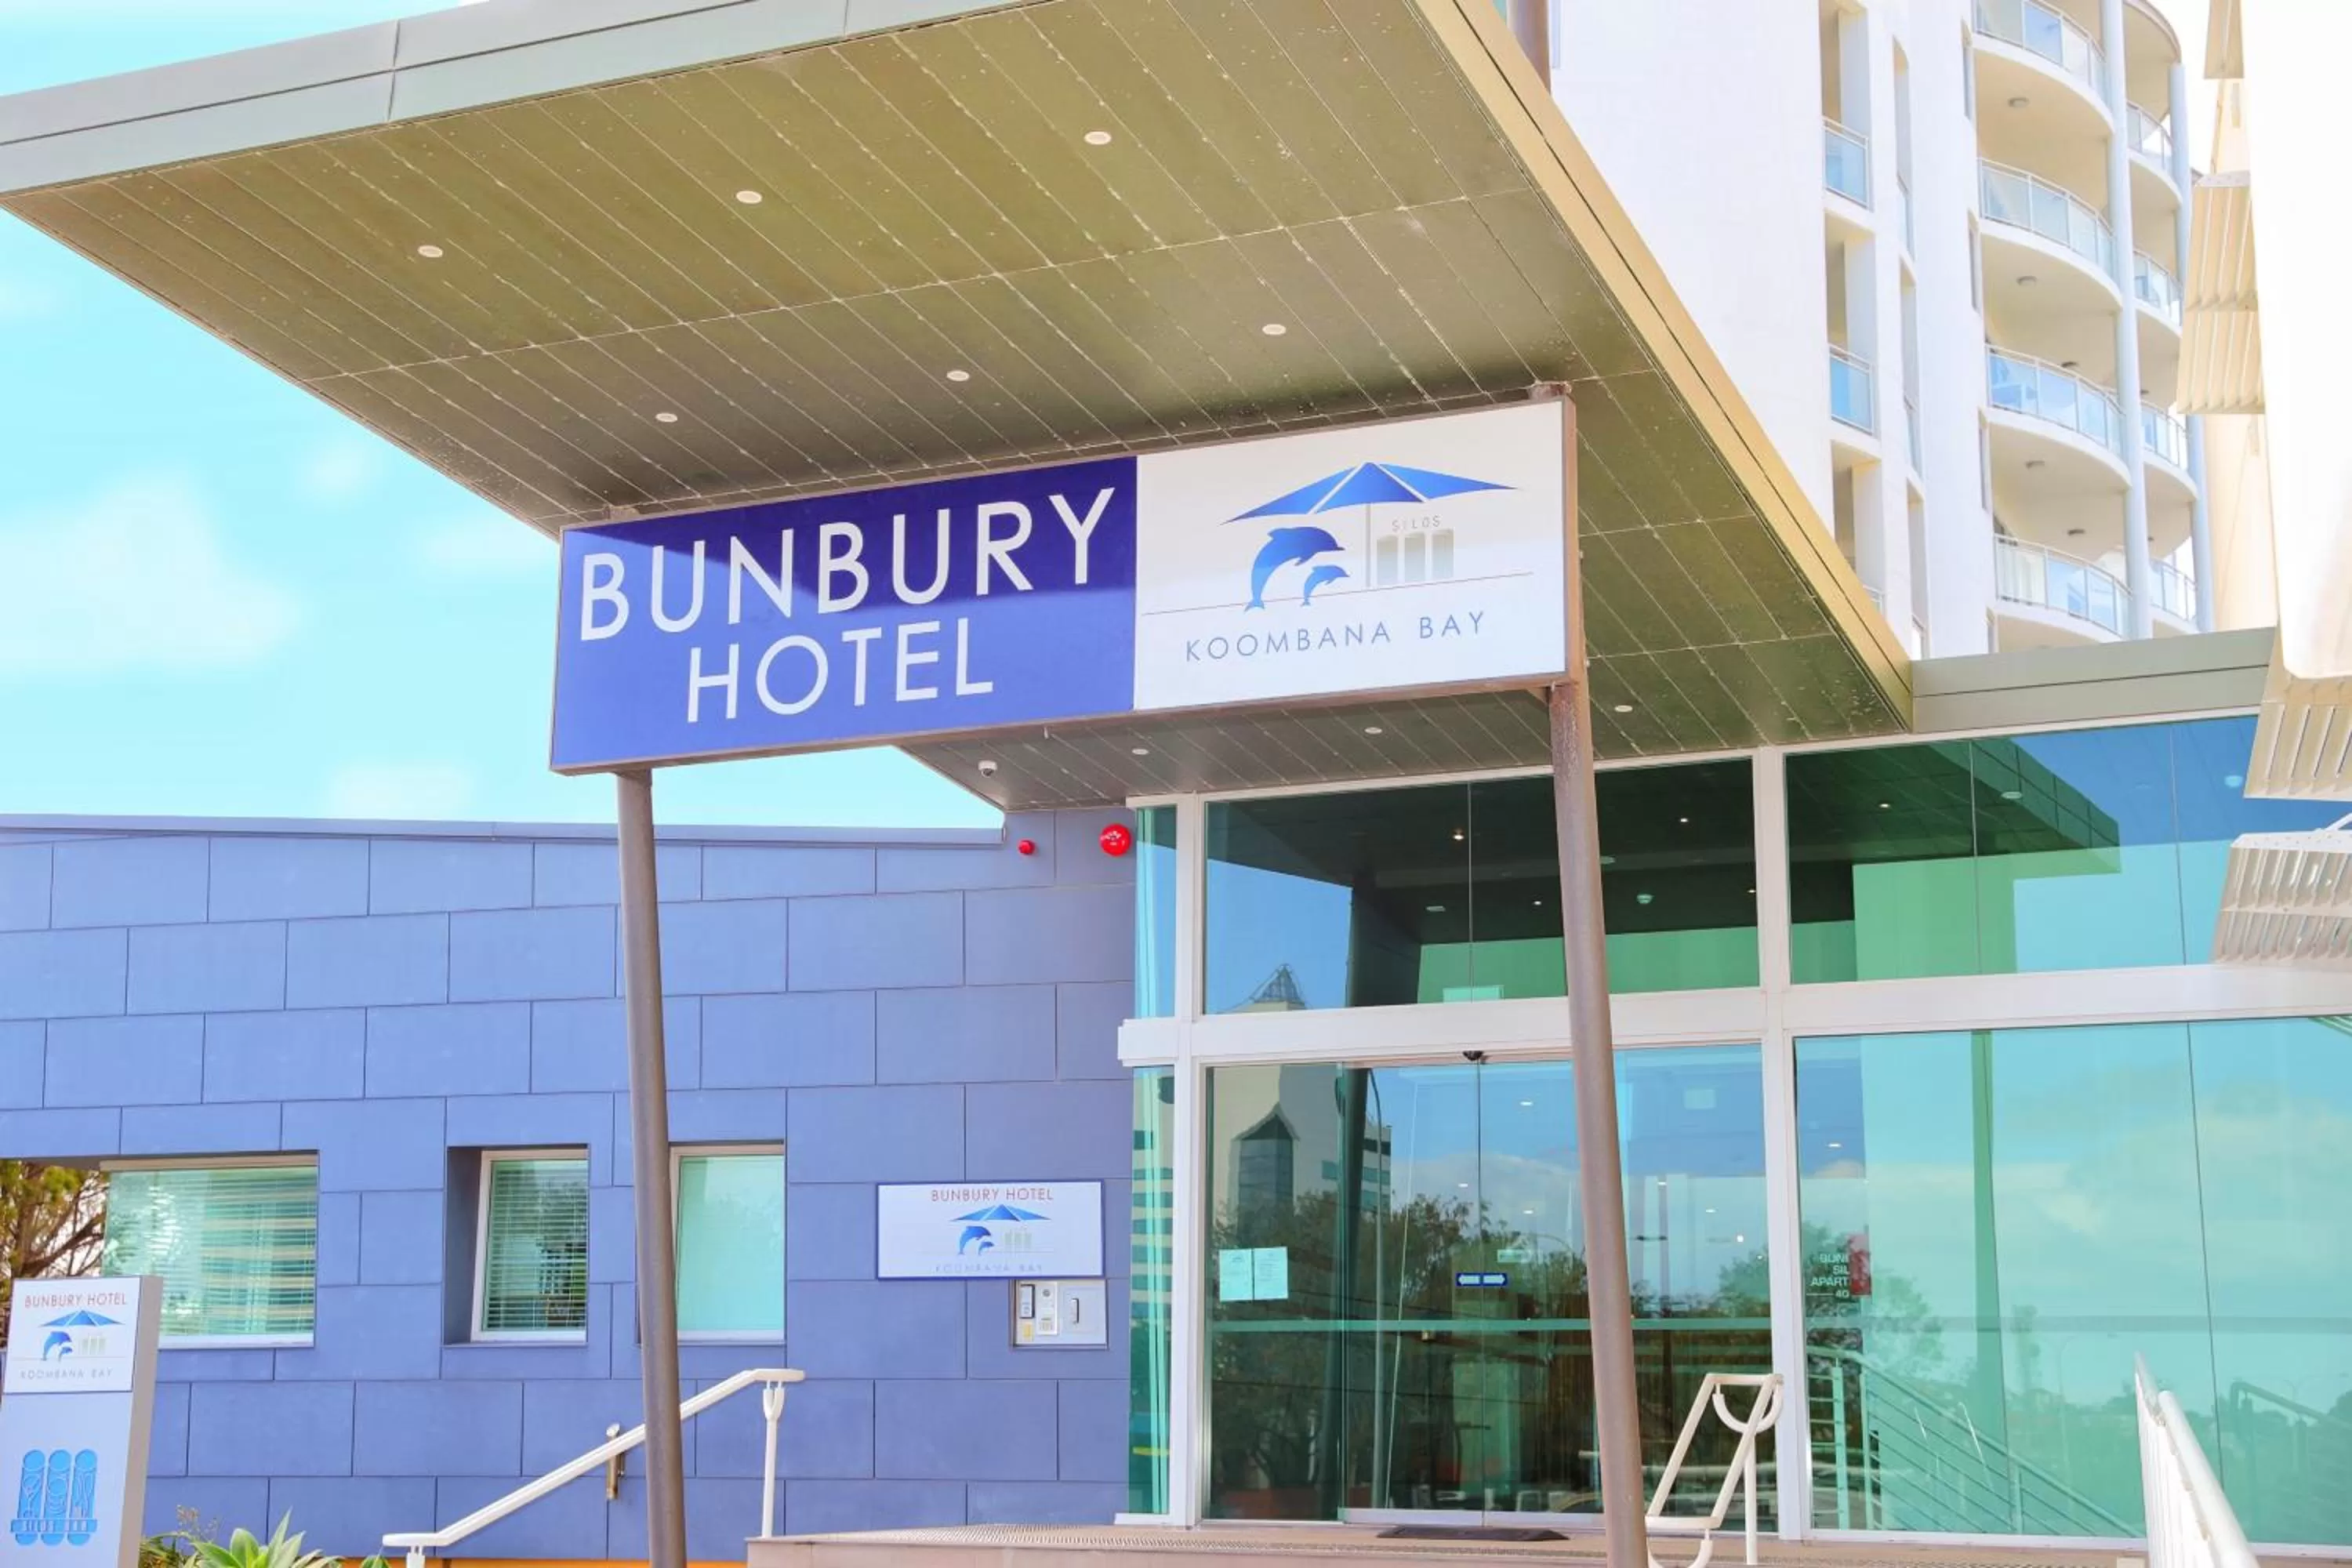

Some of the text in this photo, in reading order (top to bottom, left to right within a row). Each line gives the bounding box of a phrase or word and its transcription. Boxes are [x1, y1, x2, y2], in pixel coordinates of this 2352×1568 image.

[1392, 514, 1441, 532] SILOS
[581, 488, 1115, 641] BUNBURY
[1186, 611, 1483, 662] KOOMBANA BAY
[688, 618, 993, 723] HOTEL
[931, 1188, 1054, 1202] BUNBURY HOTEL
[24, 1293, 127, 1308] BUNBURY HOTEL
